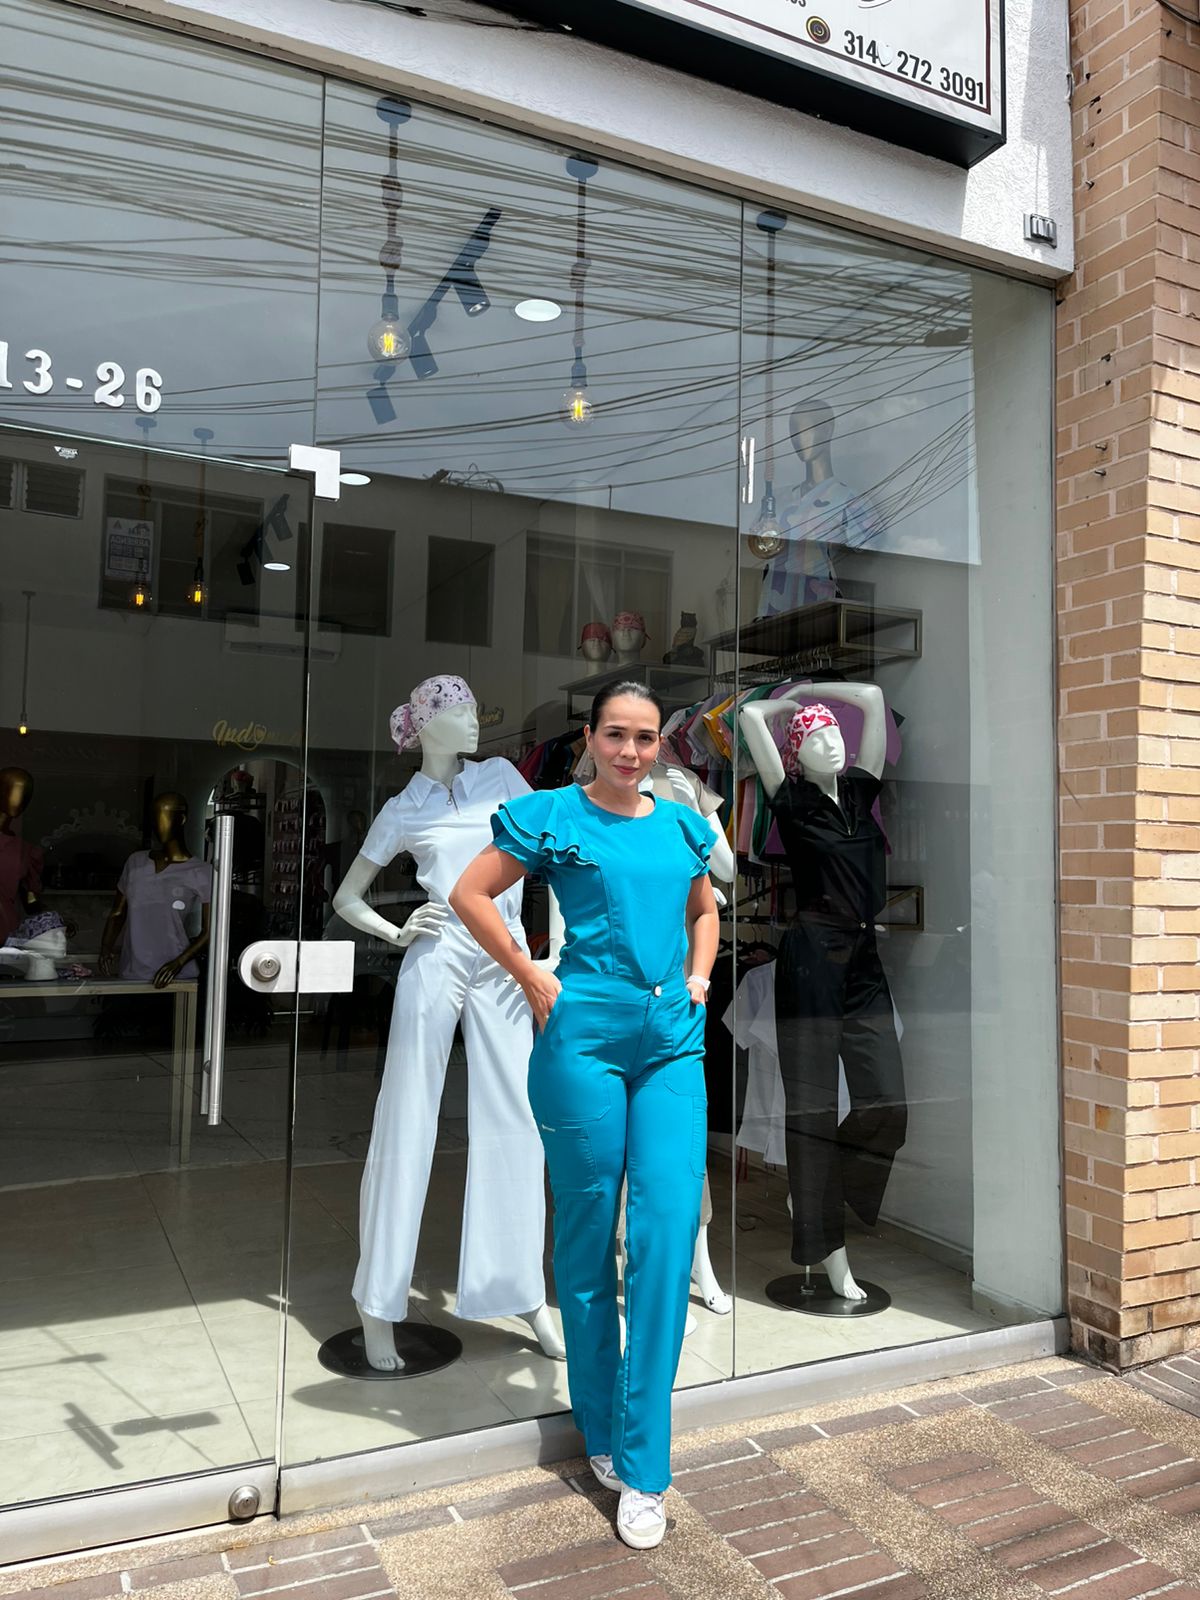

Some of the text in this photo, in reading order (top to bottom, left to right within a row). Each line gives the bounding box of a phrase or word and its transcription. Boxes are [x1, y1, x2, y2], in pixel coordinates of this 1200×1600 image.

[844, 29, 984, 105] 314 272 3091
